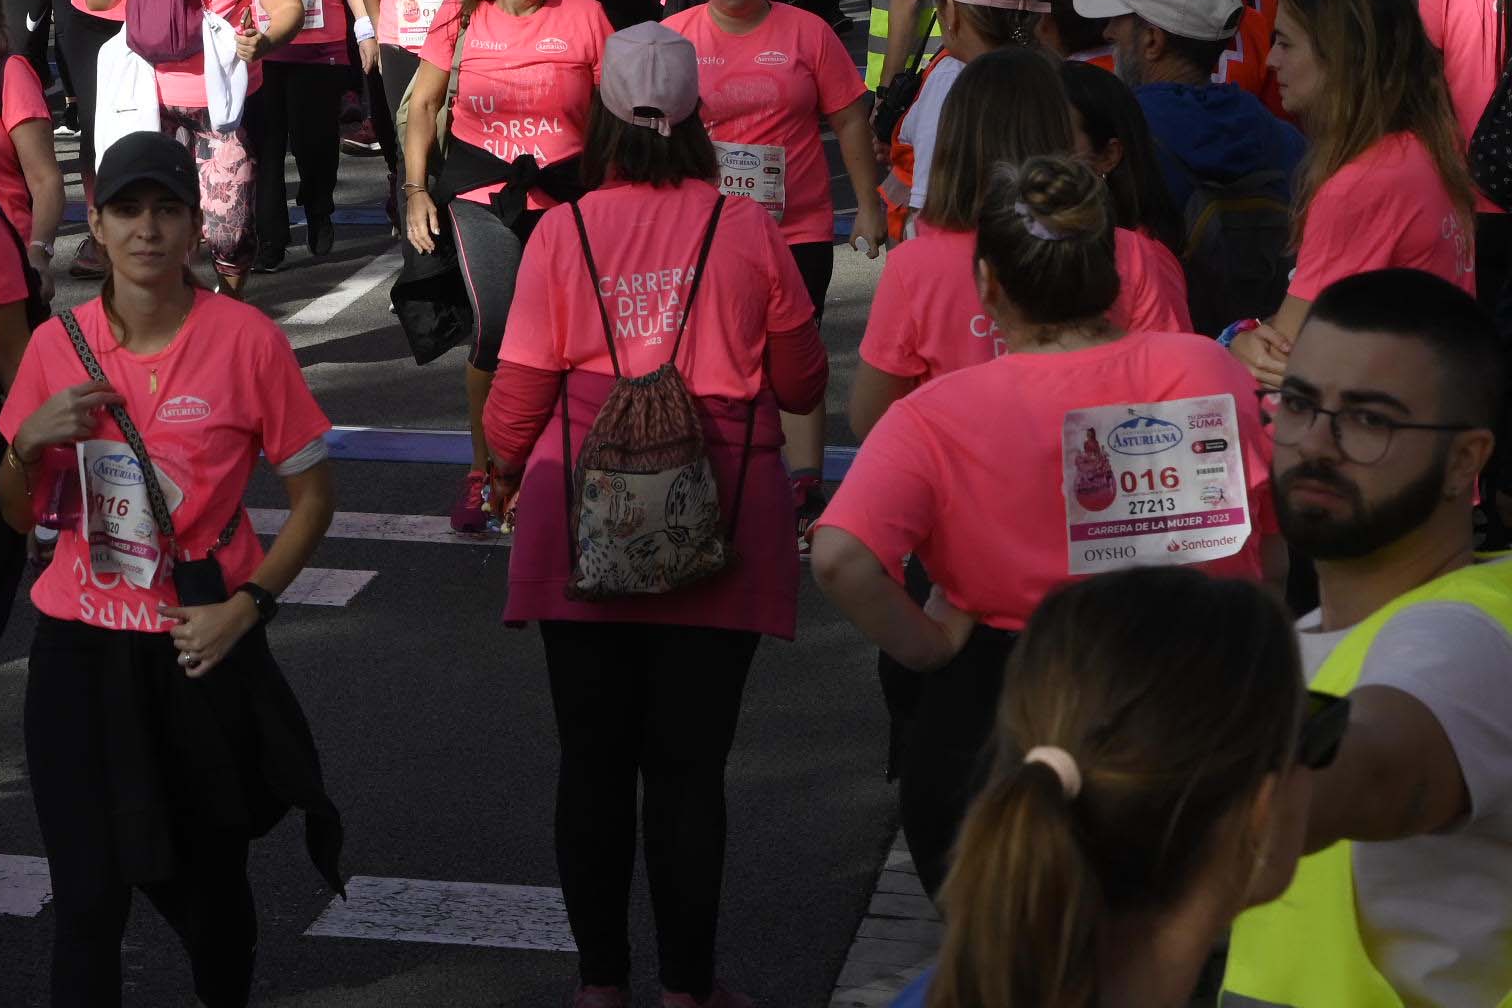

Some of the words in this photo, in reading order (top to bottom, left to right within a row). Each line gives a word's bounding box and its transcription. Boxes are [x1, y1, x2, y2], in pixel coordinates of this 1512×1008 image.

[470, 39, 507, 50] OYSHO
[469, 95, 495, 113] TU
[723, 157, 758, 167] ASTURIANA
[724, 175, 755, 188] 016
[598, 265, 695, 296] CARRERA
[618, 295, 648, 317] DE
[658, 289, 679, 312] LA
[159, 403, 207, 418] ASTURIANA
[1188, 418, 1224, 430] SUMA
[1113, 431, 1177, 449] ASTURIANA
[1120, 466, 1180, 493] 016
[1129, 497, 1176, 515] 27213
[1088, 524, 1133, 536] CARRERA
[1135, 523, 1149, 531] DE
[1152, 521, 1165, 530] LA
[1167, 516, 1203, 528] MUJER
[1206, 513, 1230, 523] 2023
[1084, 546, 1137, 562] OYSHO
[1181, 536, 1237, 552] Santander
